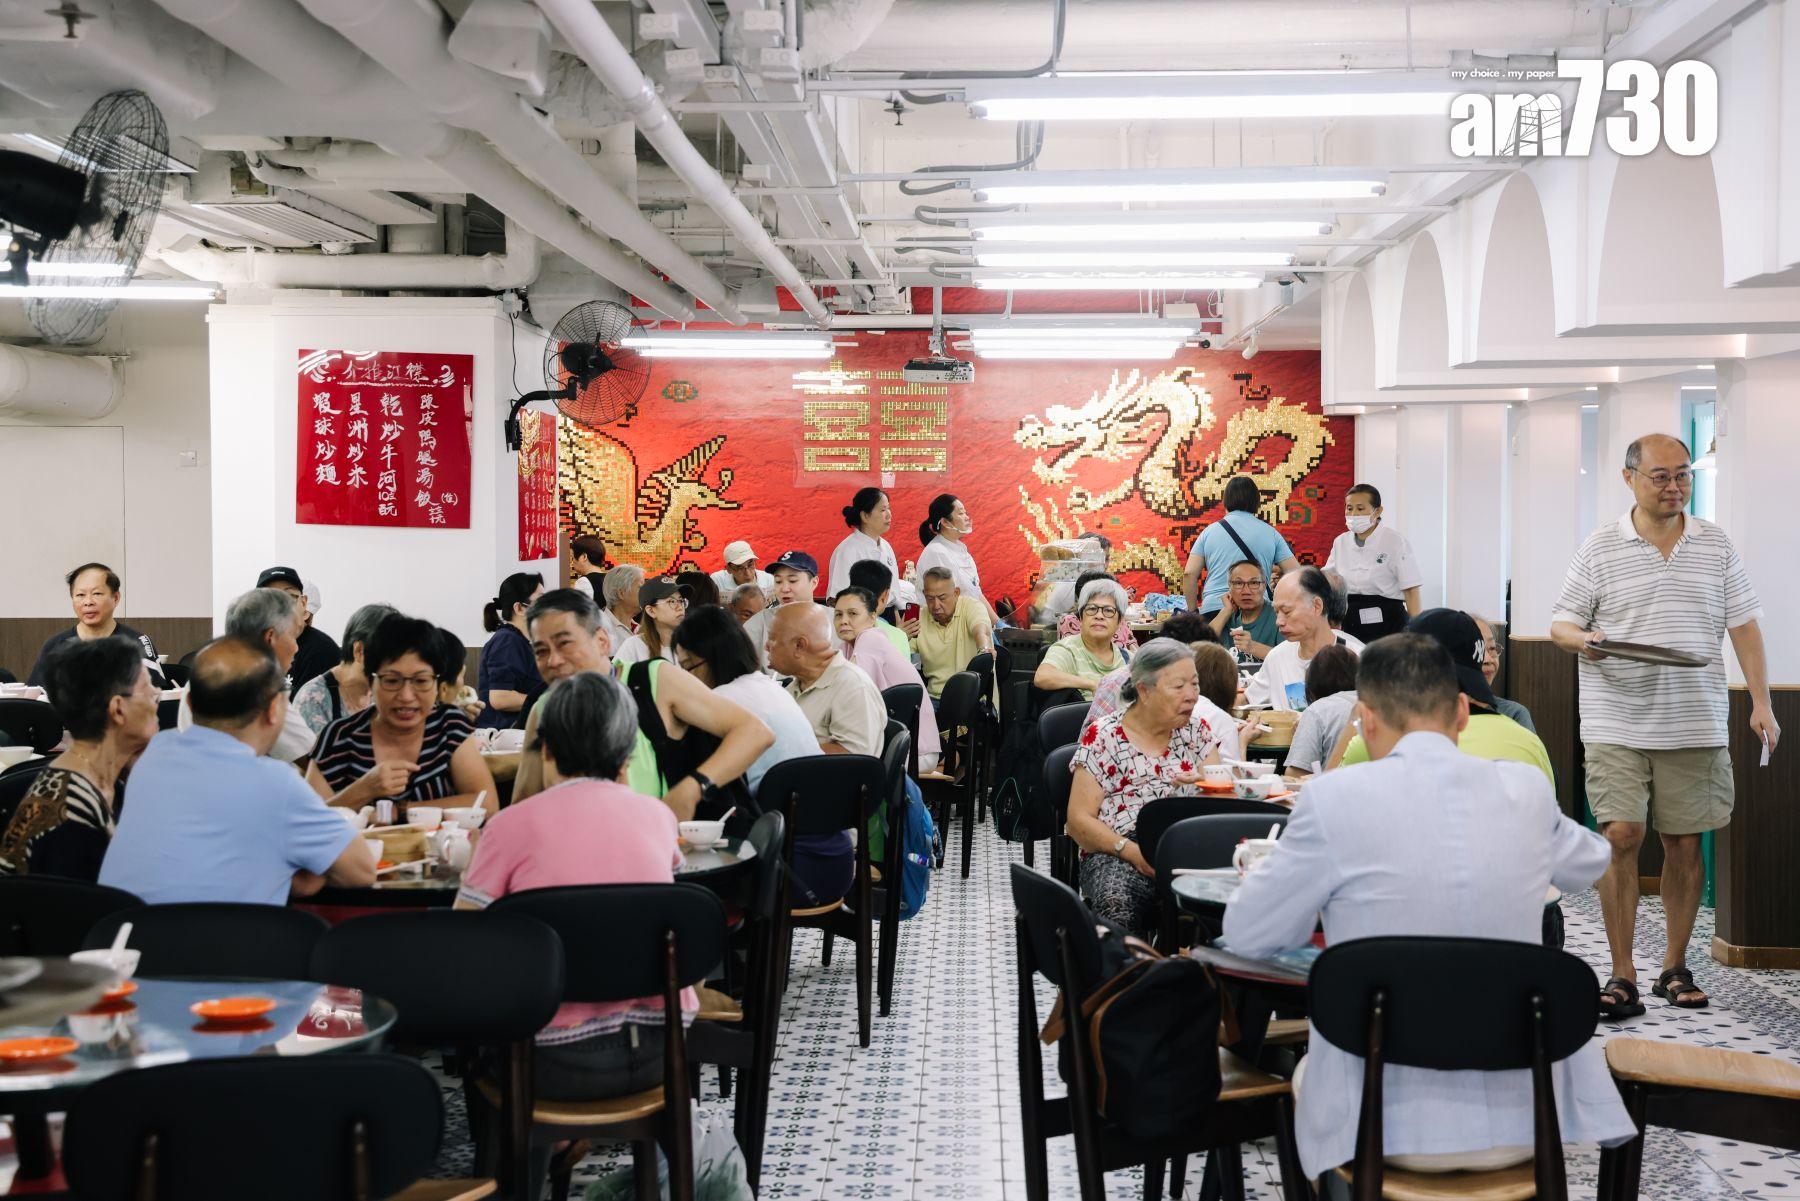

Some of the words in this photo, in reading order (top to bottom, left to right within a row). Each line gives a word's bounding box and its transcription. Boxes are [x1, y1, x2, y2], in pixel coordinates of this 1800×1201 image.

[346, 391, 369, 488] 星洲炒米
[377, 392, 405, 492] 乾炒牛河
[781, 551, 793, 561] S
